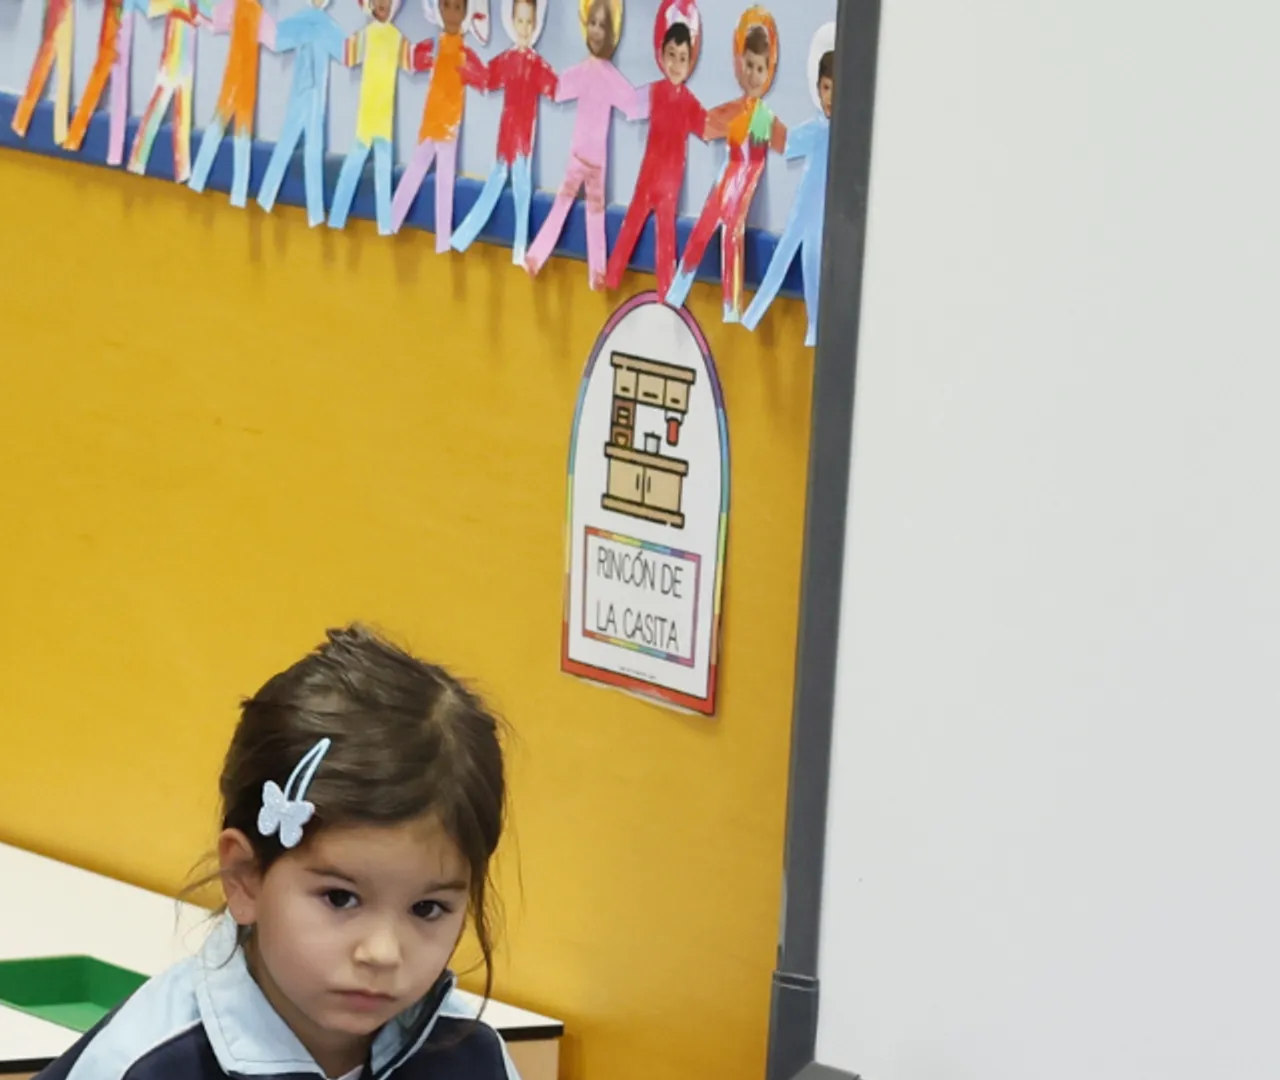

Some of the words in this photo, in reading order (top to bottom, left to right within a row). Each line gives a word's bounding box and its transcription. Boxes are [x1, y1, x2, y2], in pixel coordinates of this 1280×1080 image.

[596, 545, 656, 591] RINCÓN
[660, 562, 684, 599] DE
[596, 600, 618, 635] LA
[622, 607, 680, 653] CASITA
